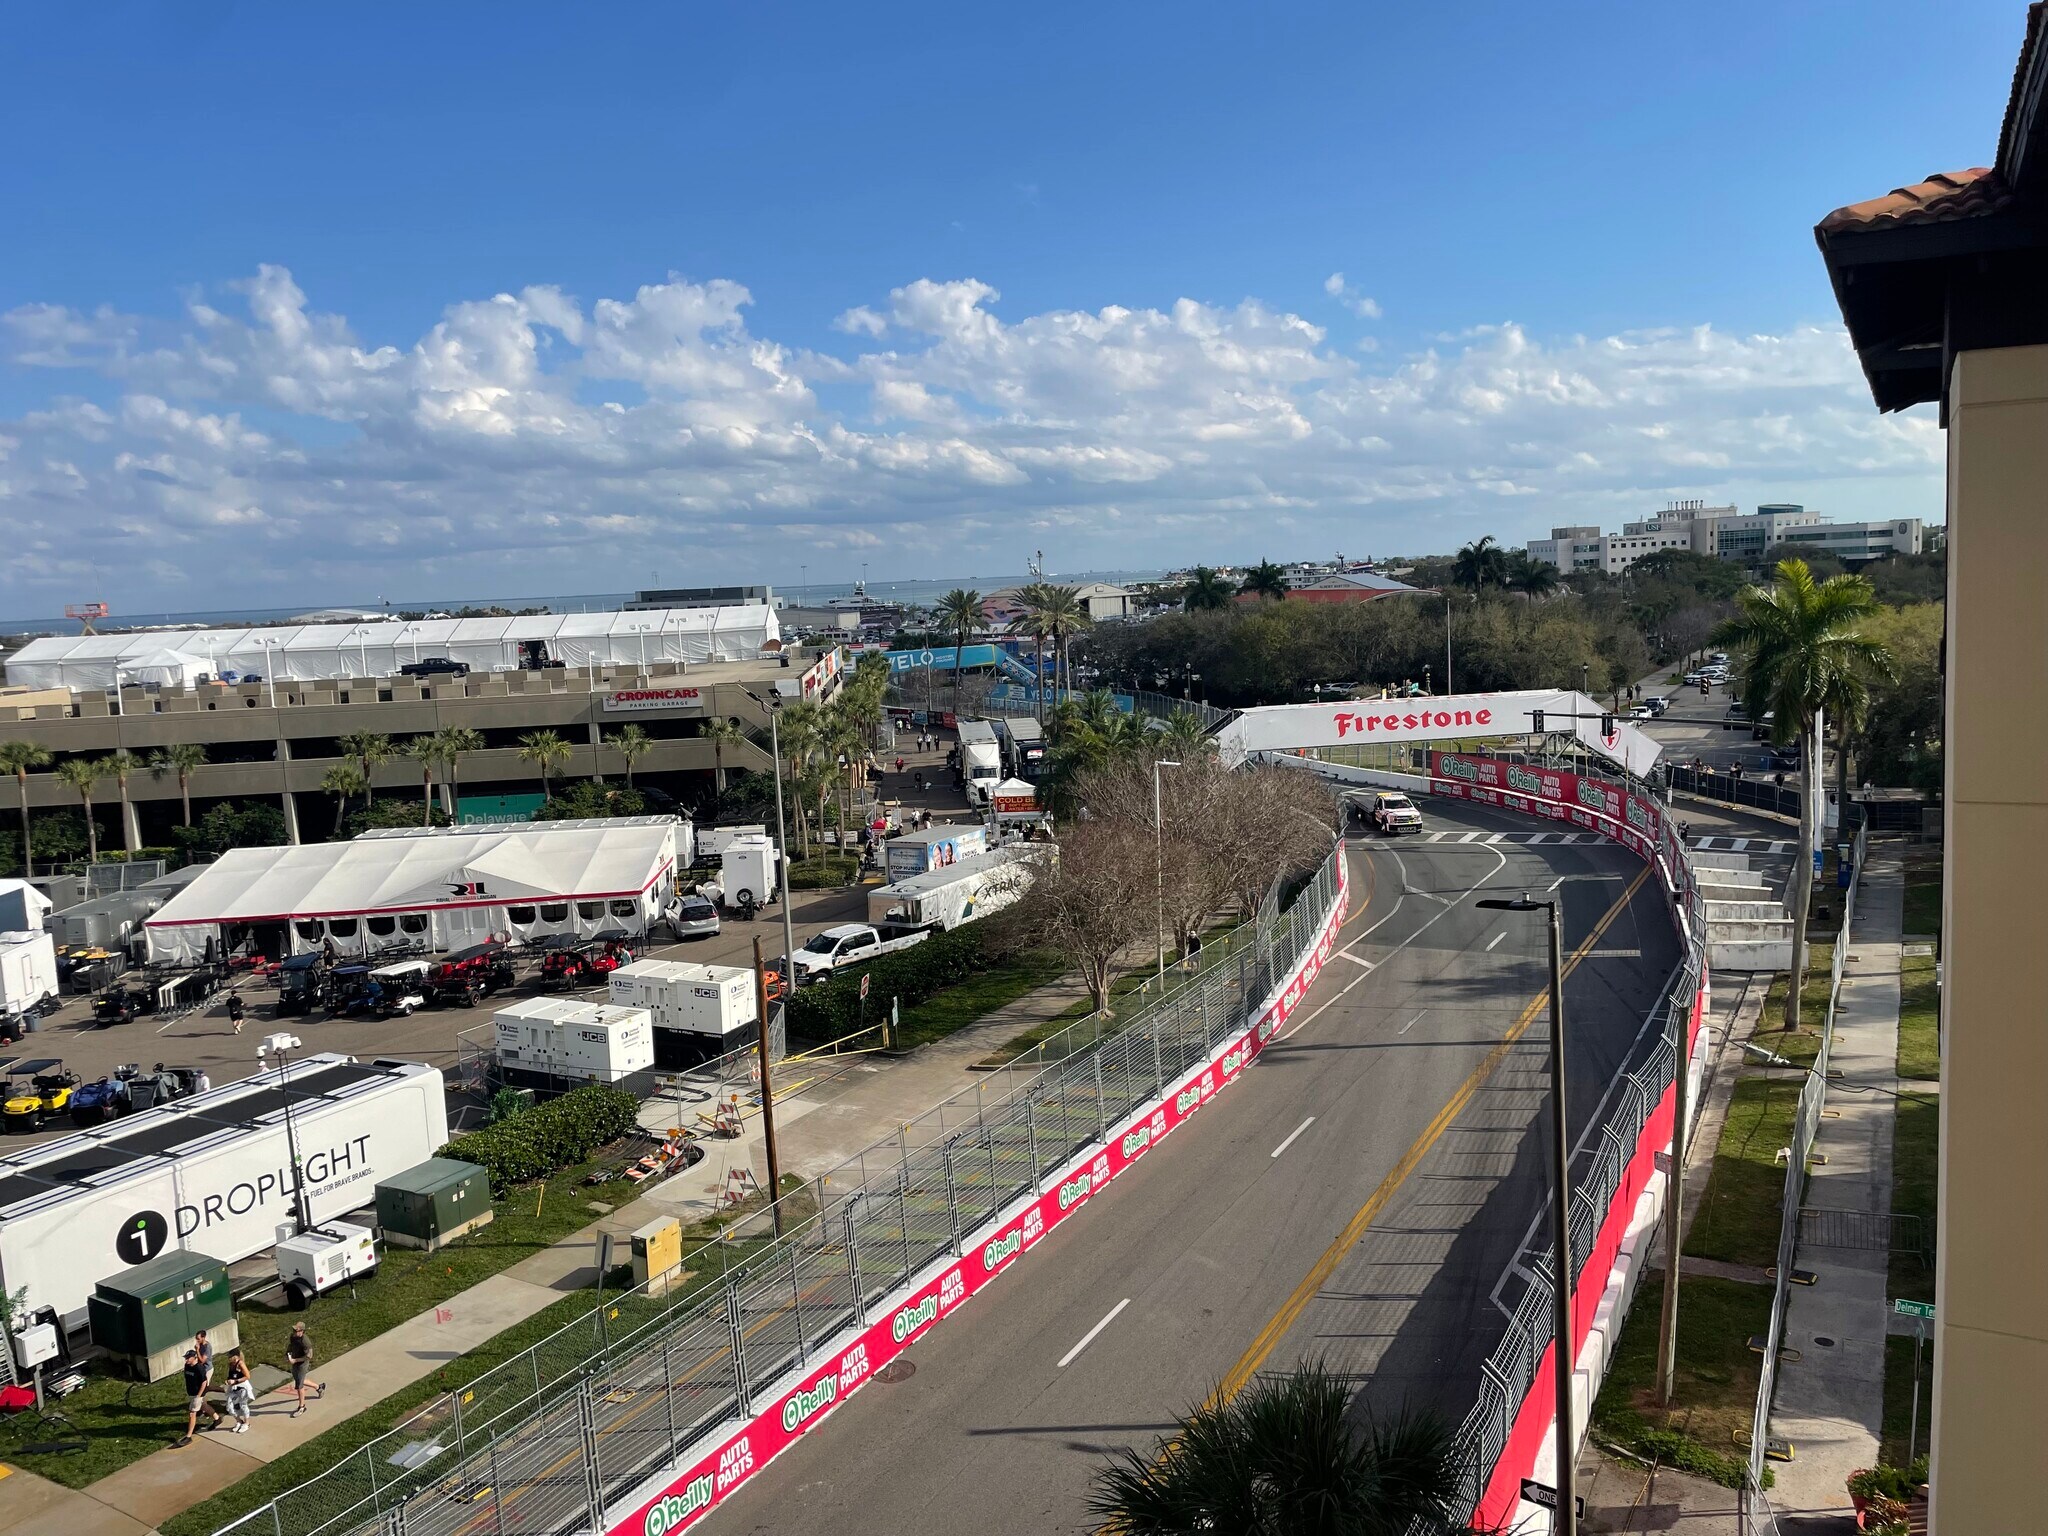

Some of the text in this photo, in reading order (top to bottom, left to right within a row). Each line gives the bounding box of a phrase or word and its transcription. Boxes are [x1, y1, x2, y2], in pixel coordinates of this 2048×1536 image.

[616, 689, 698, 701] CROWNCARS
[1333, 709, 1492, 738] Firestone
[1441, 756, 1478, 781] O'Reilly
[1479, 773, 1498, 785] PARTS
[1480, 763, 1496, 775] AUTO
[1508, 765, 1541, 794] O'Reilly
[1541, 786, 1562, 799] PARTS
[1543, 775, 1560, 788] AUTO
[1579, 780, 1606, 812] O'Reilly
[1607, 791, 1619, 804] AUTO
[464, 813, 527, 825] Delaware
[1605, 801, 1620, 817] PARTS
[696, 988, 718, 998] JCB
[583, 1033, 605, 1042] JCB
[1151, 1122, 1166, 1139] PARTS
[1152, 1110, 1165, 1127] AUTO
[1124, 1129, 1149, 1157] O'Reilly
[1092, 1154, 1107, 1174] AUTO
[310, 1167, 371, 1198] FUEL FOR BRAVE BRANDS
[1092, 1166, 1109, 1187] PARTS
[1060, 1176, 1091, 1209] O'Reilly
[1024, 1207, 1041, 1229] AUTO
[1023, 1220, 1043, 1244] PARTS
[985, 1232, 1021, 1269] O'Reilly
[941, 1269, 961, 1294] AUTO
[940, 1281, 964, 1310] PARTS
[894, 1297, 937, 1341] O'Reilly
[1896, 1301, 1921, 1315] Delmar
[841, 1343, 865, 1373] AUTO
[840, 1357, 869, 1391] PARTS
[785, 1376, 837, 1431] O'Reilly
[720, 1437, 749, 1472] AUTO
[717, 1451, 753, 1492] PARTS
[647, 1477, 711, 1536] O'Reilly
[1539, 1491, 1556, 1504] ONE
